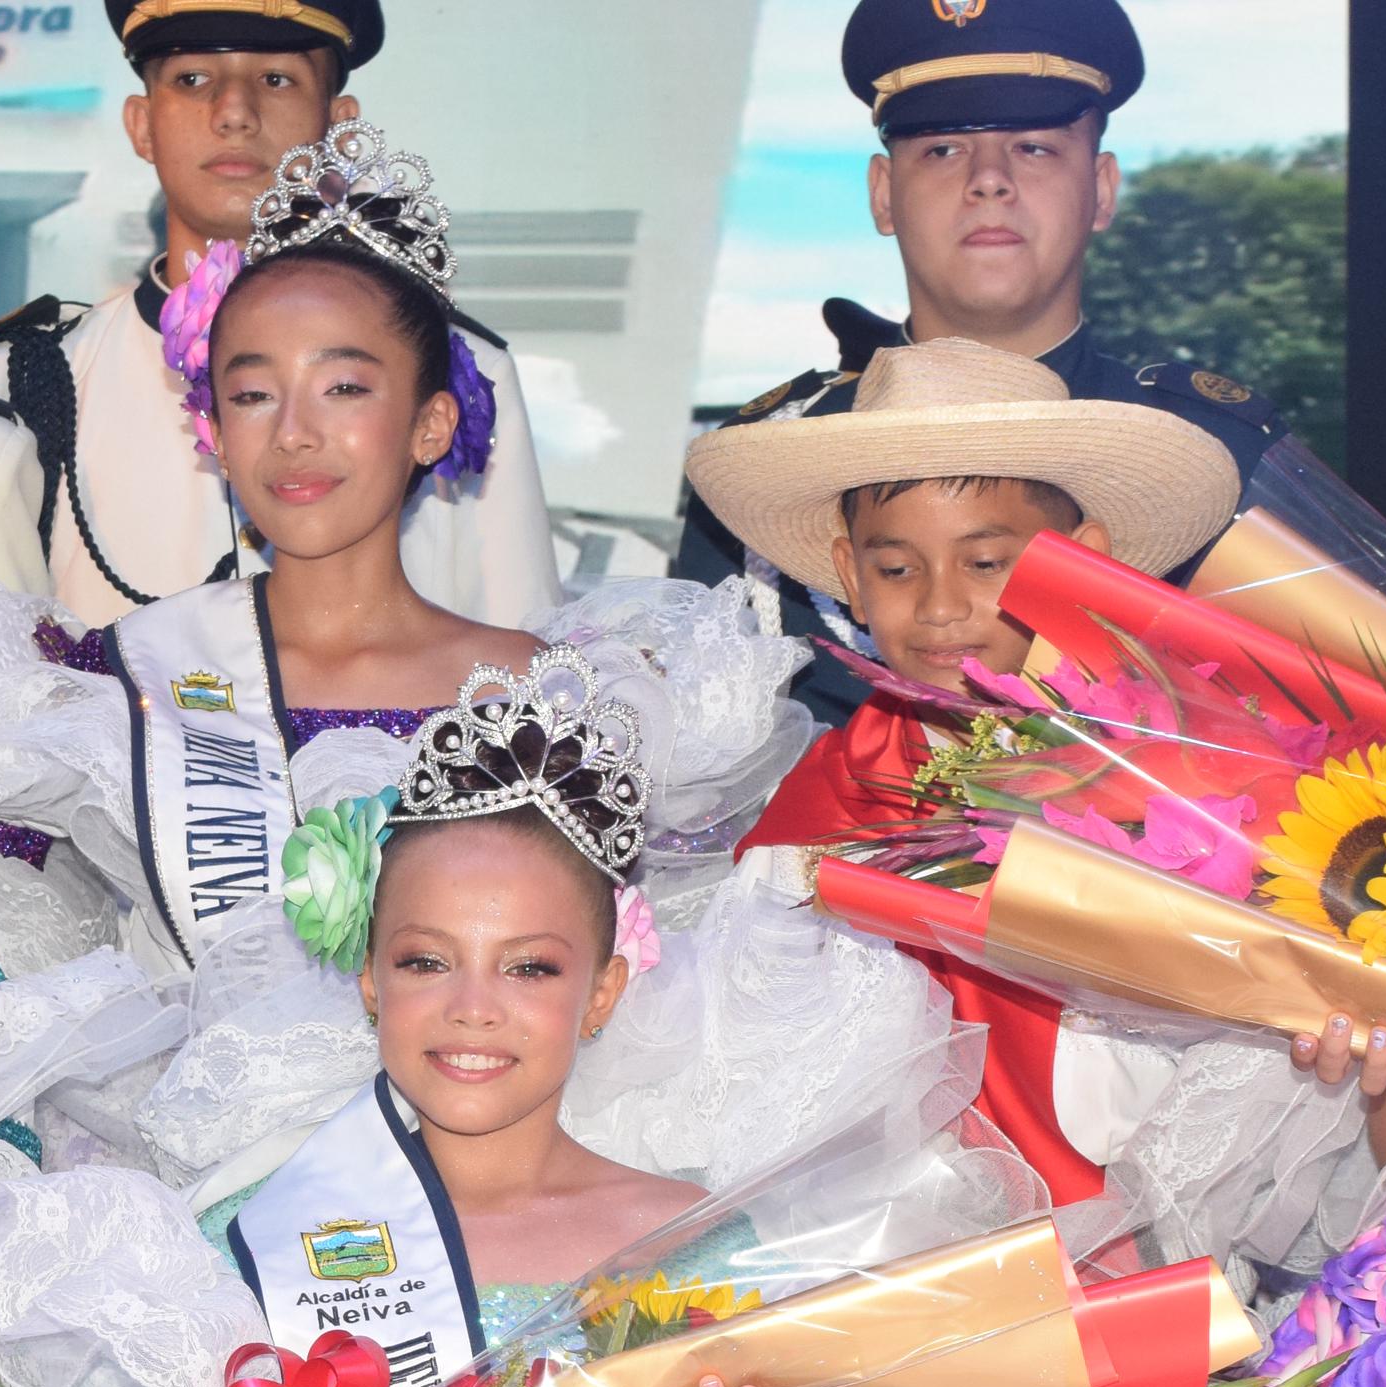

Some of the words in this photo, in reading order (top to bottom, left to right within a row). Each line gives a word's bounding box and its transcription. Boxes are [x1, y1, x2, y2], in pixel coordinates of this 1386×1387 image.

[185, 803, 270, 922] NEIVA
[296, 1282, 388, 1306] Alcaldía
[399, 1279, 426, 1294] de
[316, 1301, 414, 1330] Neiva
